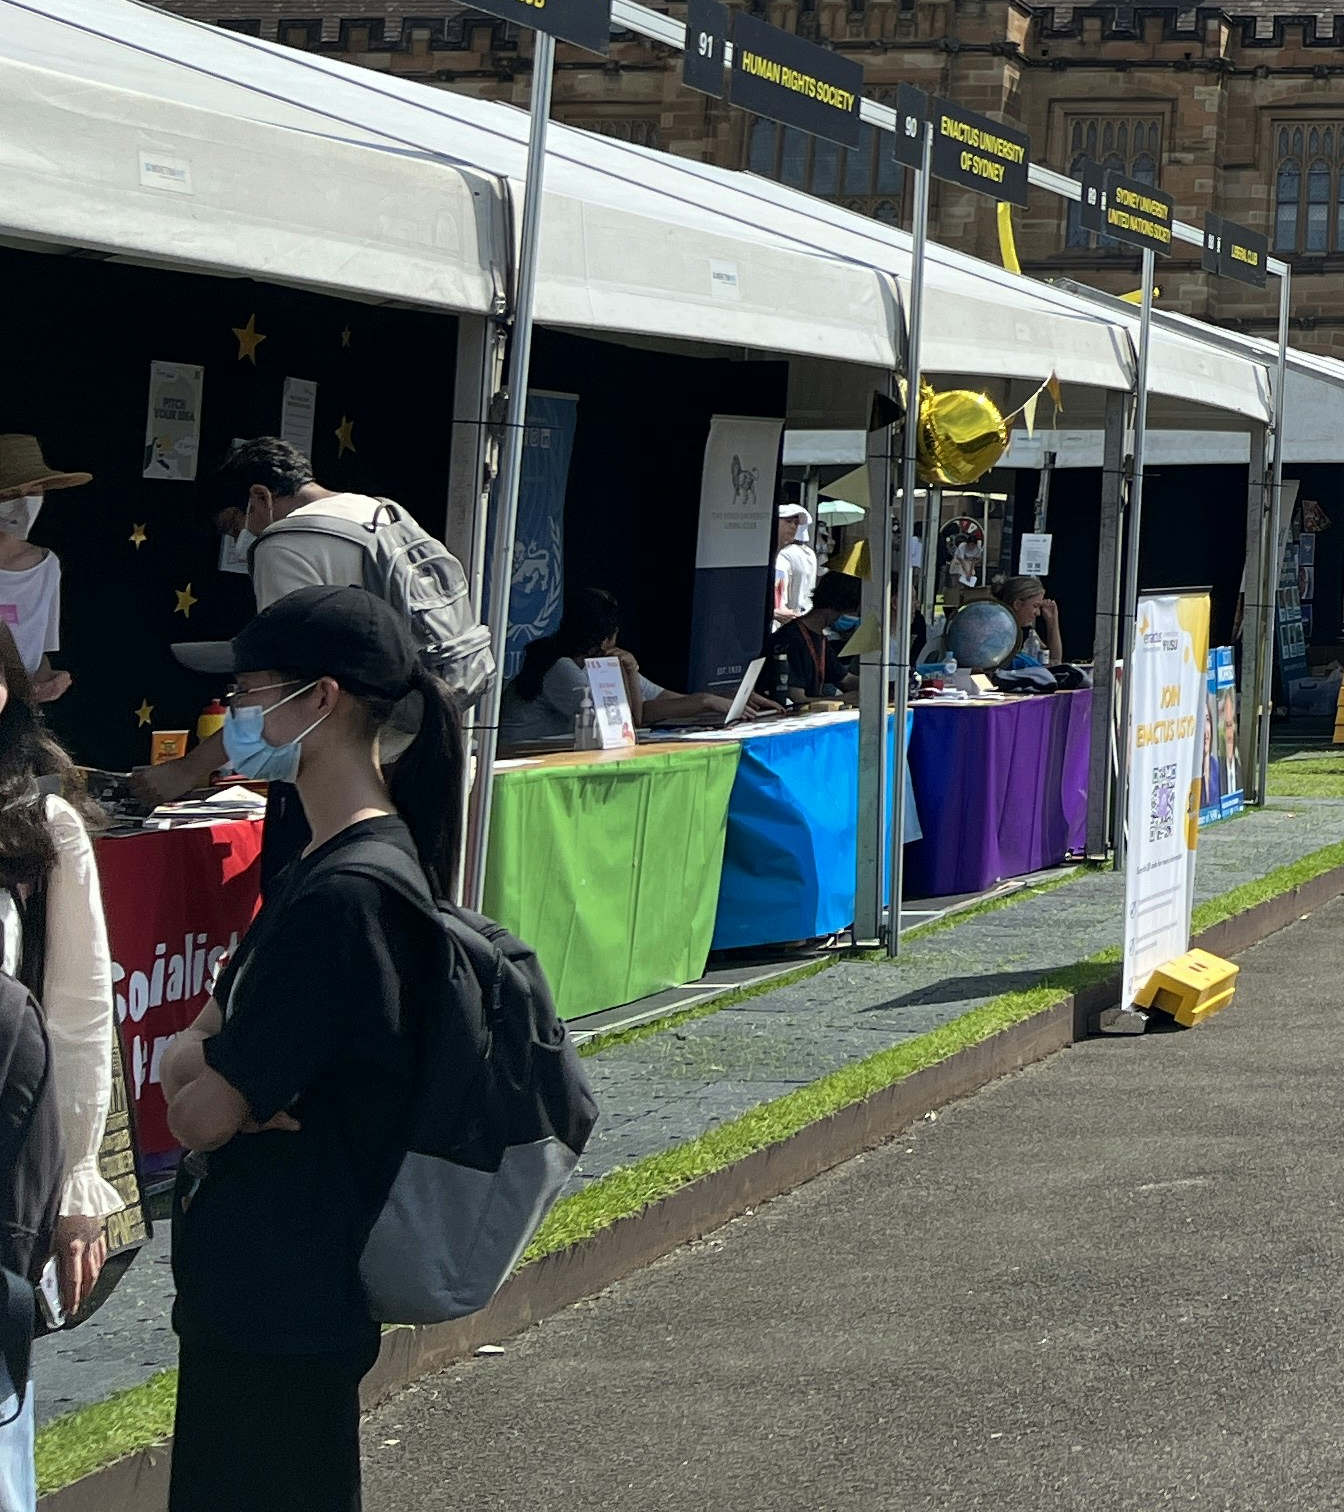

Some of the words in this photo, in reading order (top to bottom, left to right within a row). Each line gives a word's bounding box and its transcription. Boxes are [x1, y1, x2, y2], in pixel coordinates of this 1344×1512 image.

[698, 32, 713, 58] 91
[742, 50, 781, 84] HUMAN
[781, 67, 816, 98] RIGHTS
[816, 81, 855, 113] SOCIETY
[905, 116, 917, 138] 90
[941, 115, 979, 147] ENACTUS
[980, 131, 1025, 164] UNIVERSITY
[960, 151, 973, 171] OF
[973, 155, 1005, 183] SYDNEY
[163, 397, 187, 410] PITCH
[1161, 684, 1181, 709] JOIN
[1136, 719, 1176, 748] ENACTUS
